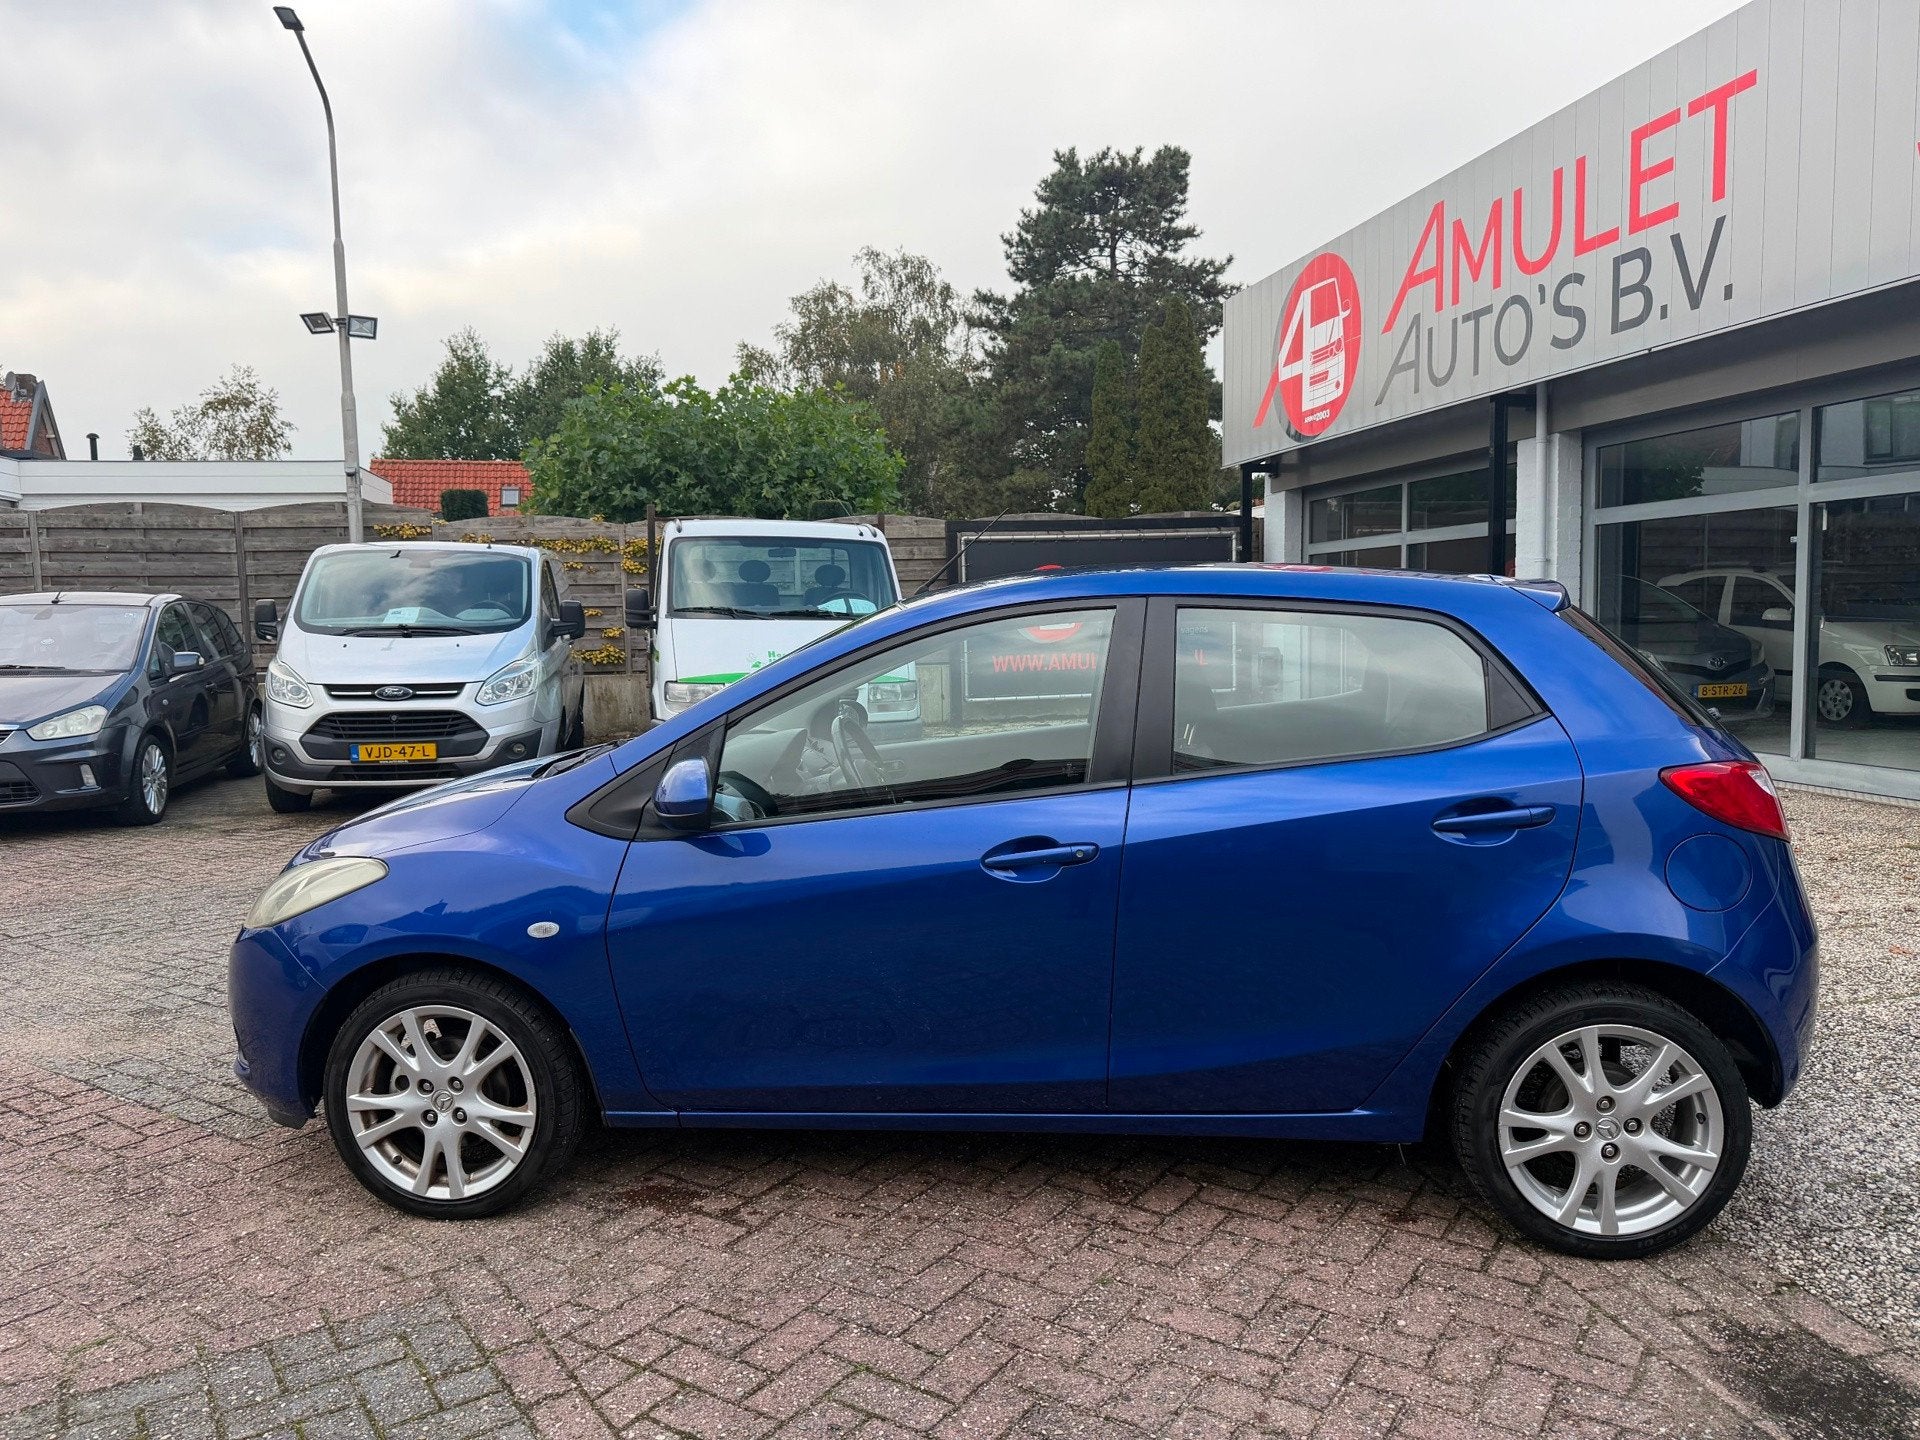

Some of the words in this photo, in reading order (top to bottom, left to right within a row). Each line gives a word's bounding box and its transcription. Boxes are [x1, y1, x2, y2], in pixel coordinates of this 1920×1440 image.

[1381, 68, 1757, 335] AMULET
[1374, 272, 1587, 406] AUTO'S
[1610, 215, 1733, 335] B.V.
[383, 688, 404, 696] Ford
[1701, 685, 1744, 696] 8-STR-26
[365, 746, 430, 759] VJD-47-L
